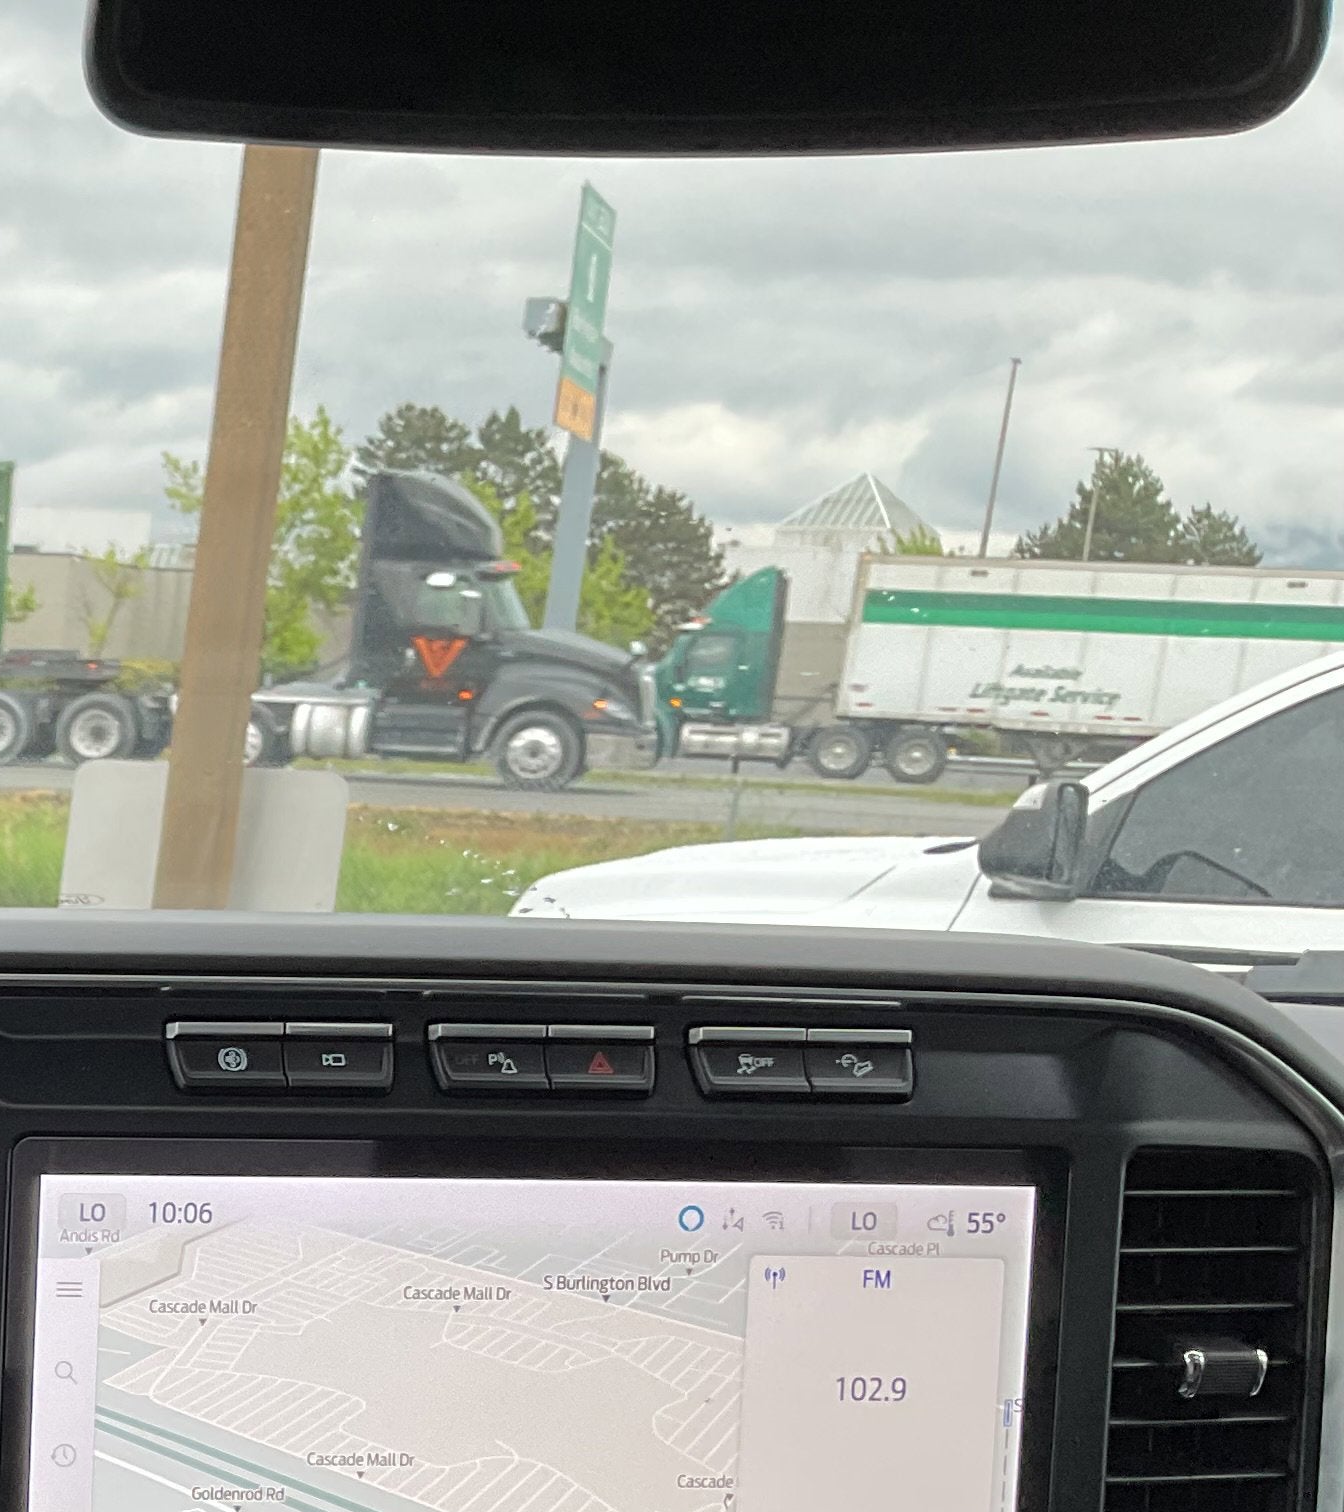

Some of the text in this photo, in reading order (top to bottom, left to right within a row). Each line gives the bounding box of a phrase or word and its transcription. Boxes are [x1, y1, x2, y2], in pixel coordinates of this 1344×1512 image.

[79, 1203, 107, 1222] LO
[148, 1201, 213, 1225] 10:06
[851, 1211, 878, 1231] LO
[966, 1211, 1007, 1234] 55°
[59, 1228, 120, 1243] Andis Rd
[867, 1241, 924, 1256] Cascade
[660, 1249, 720, 1266] Pump Dr
[543, 1274, 670, 1294] S Burlington Blvd
[862, 1269, 892, 1289] FM
[403, 1286, 511, 1301] Cascade Mall Dr
[149, 1300, 258, 1315] Cascade Mall Dr
[835, 1376, 907, 1402] 102.9
[306, 1452, 414, 1467] Cascade Mall Dr
[677, 1474, 734, 1489] Cascade
[191, 1486, 285, 1502] Goldenrod Rd
